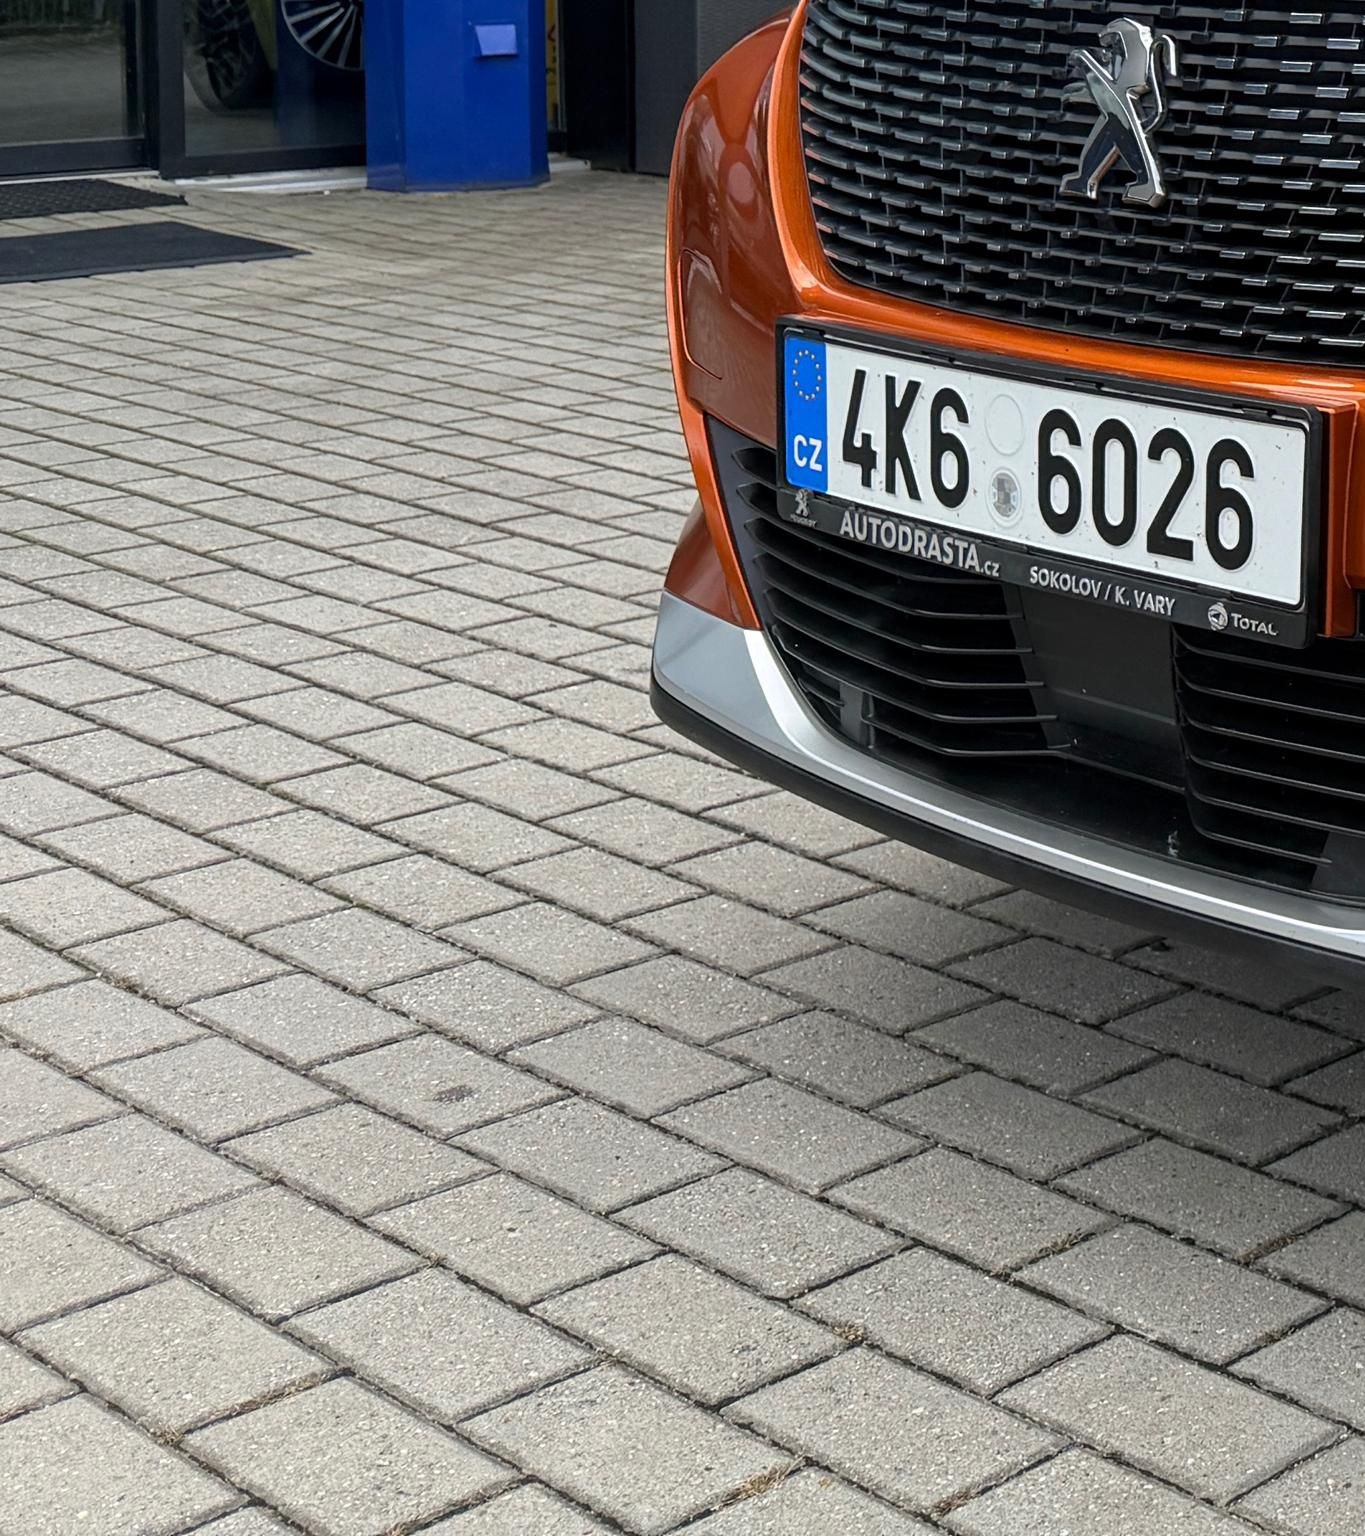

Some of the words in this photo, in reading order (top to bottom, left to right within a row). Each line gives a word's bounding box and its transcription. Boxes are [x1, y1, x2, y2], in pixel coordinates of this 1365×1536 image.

[793, 432, 823, 473] CZ
[841, 368, 970, 510] 4K6
[1036, 407, 1255, 571] 6026
[840, 510, 1000, 577] AUTODRASTA.cz
[1029, 565, 1102, 598] SOKOLOV
[1103, 583, 1111, 601] /
[1115, 585, 1130, 606] K.
[1134, 589, 1176, 616] VARY
